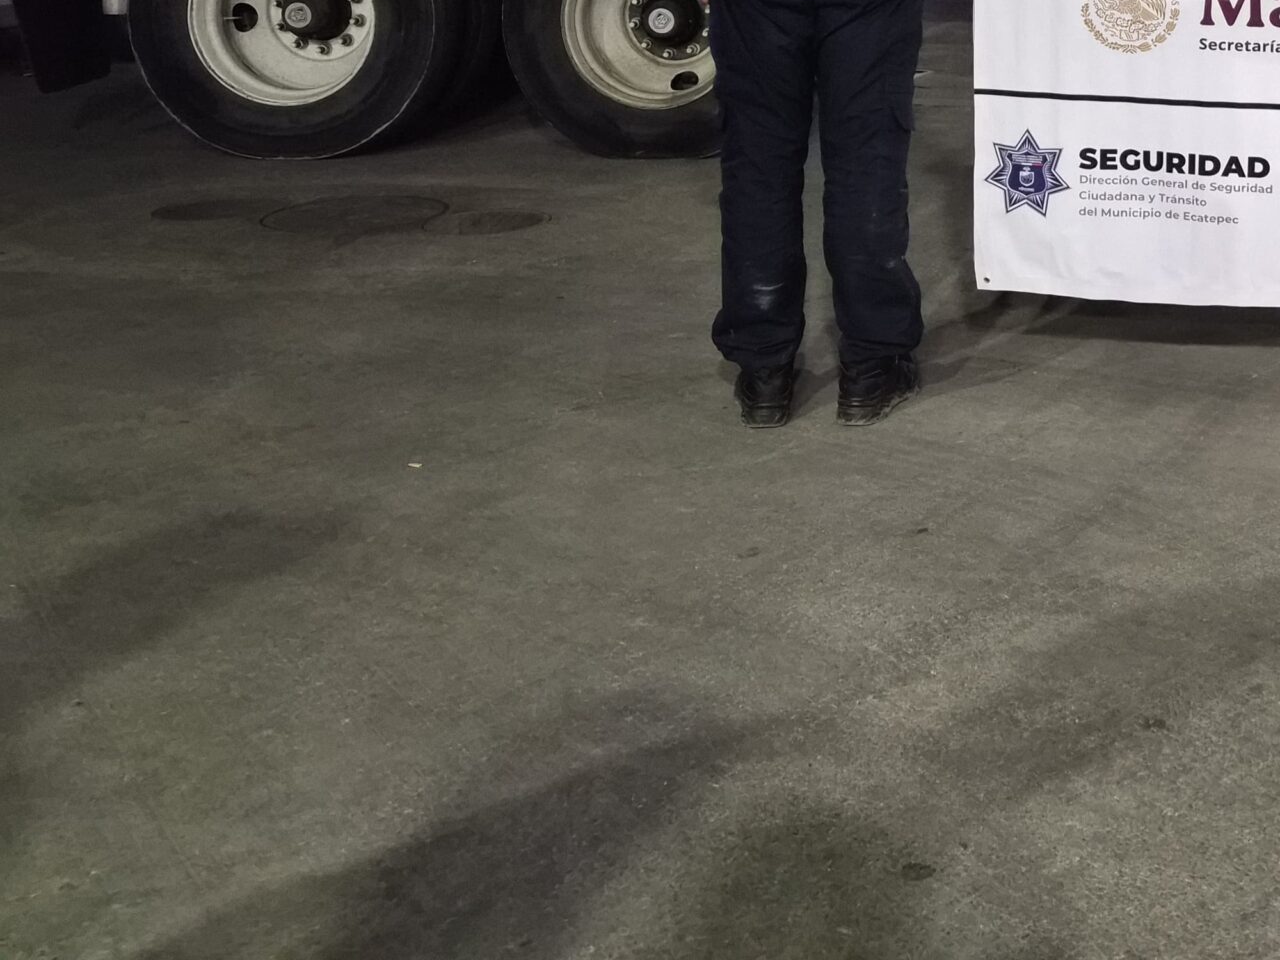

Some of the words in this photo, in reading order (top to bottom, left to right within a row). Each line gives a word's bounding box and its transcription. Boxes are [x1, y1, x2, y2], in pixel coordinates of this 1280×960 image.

[1078, 147, 1271, 178] SEGURIDAD
[1079, 174, 1138, 186] Dirección
[1141, 176, 1188, 189] General
[1191, 180, 1207, 191] de
[1209, 182, 1273, 194] Seguridad
[1078, 190, 1145, 202] Ciudadana
[1149, 194, 1156, 204] y
[1158, 193, 1207, 207] Tránsito
[1078, 207, 1098, 216] del
[1101, 208, 1162, 220] Municipio
[1165, 210, 1180, 220] de
[1183, 212, 1239, 226] Ecatepec
